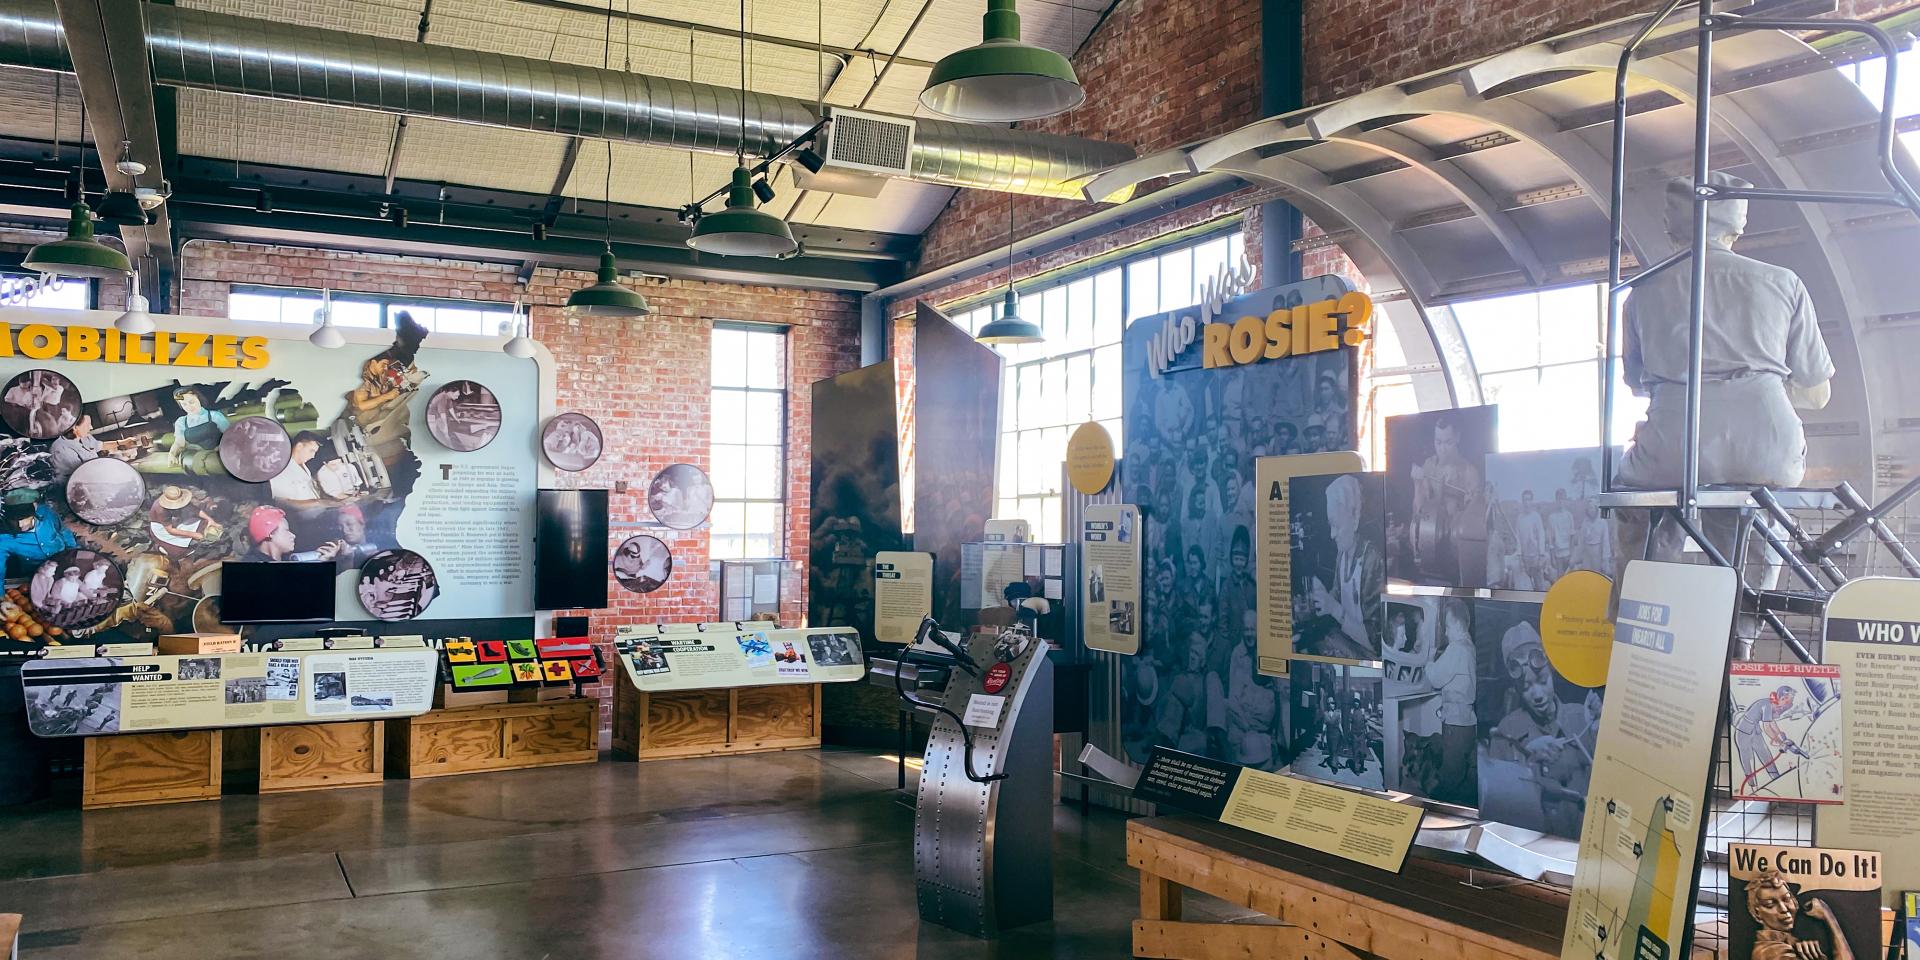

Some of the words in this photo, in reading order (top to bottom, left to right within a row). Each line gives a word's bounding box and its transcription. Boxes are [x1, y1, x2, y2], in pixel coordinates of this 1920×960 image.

[1146, 312, 1196, 379] Who
[1200, 253, 1256, 325] Was
[1203, 291, 1373, 369] ROSIE?
[0, 322, 271, 369] OBILIZES
[1636, 604, 1651, 621] JOBS
[1651, 606, 1663, 623] FOR
[1857, 621, 1904, 643] WHO
[132, 674, 163, 682] WANTED
[1732, 663, 1765, 672] ROSIE
[1768, 663, 1790, 673] THE
[1793, 664, 1840, 674] RIVETER
[1735, 848, 1768, 872] We
[1776, 850, 1811, 875] Can
[1820, 852, 1846, 877] Do
[1854, 854, 1877, 879] It!
